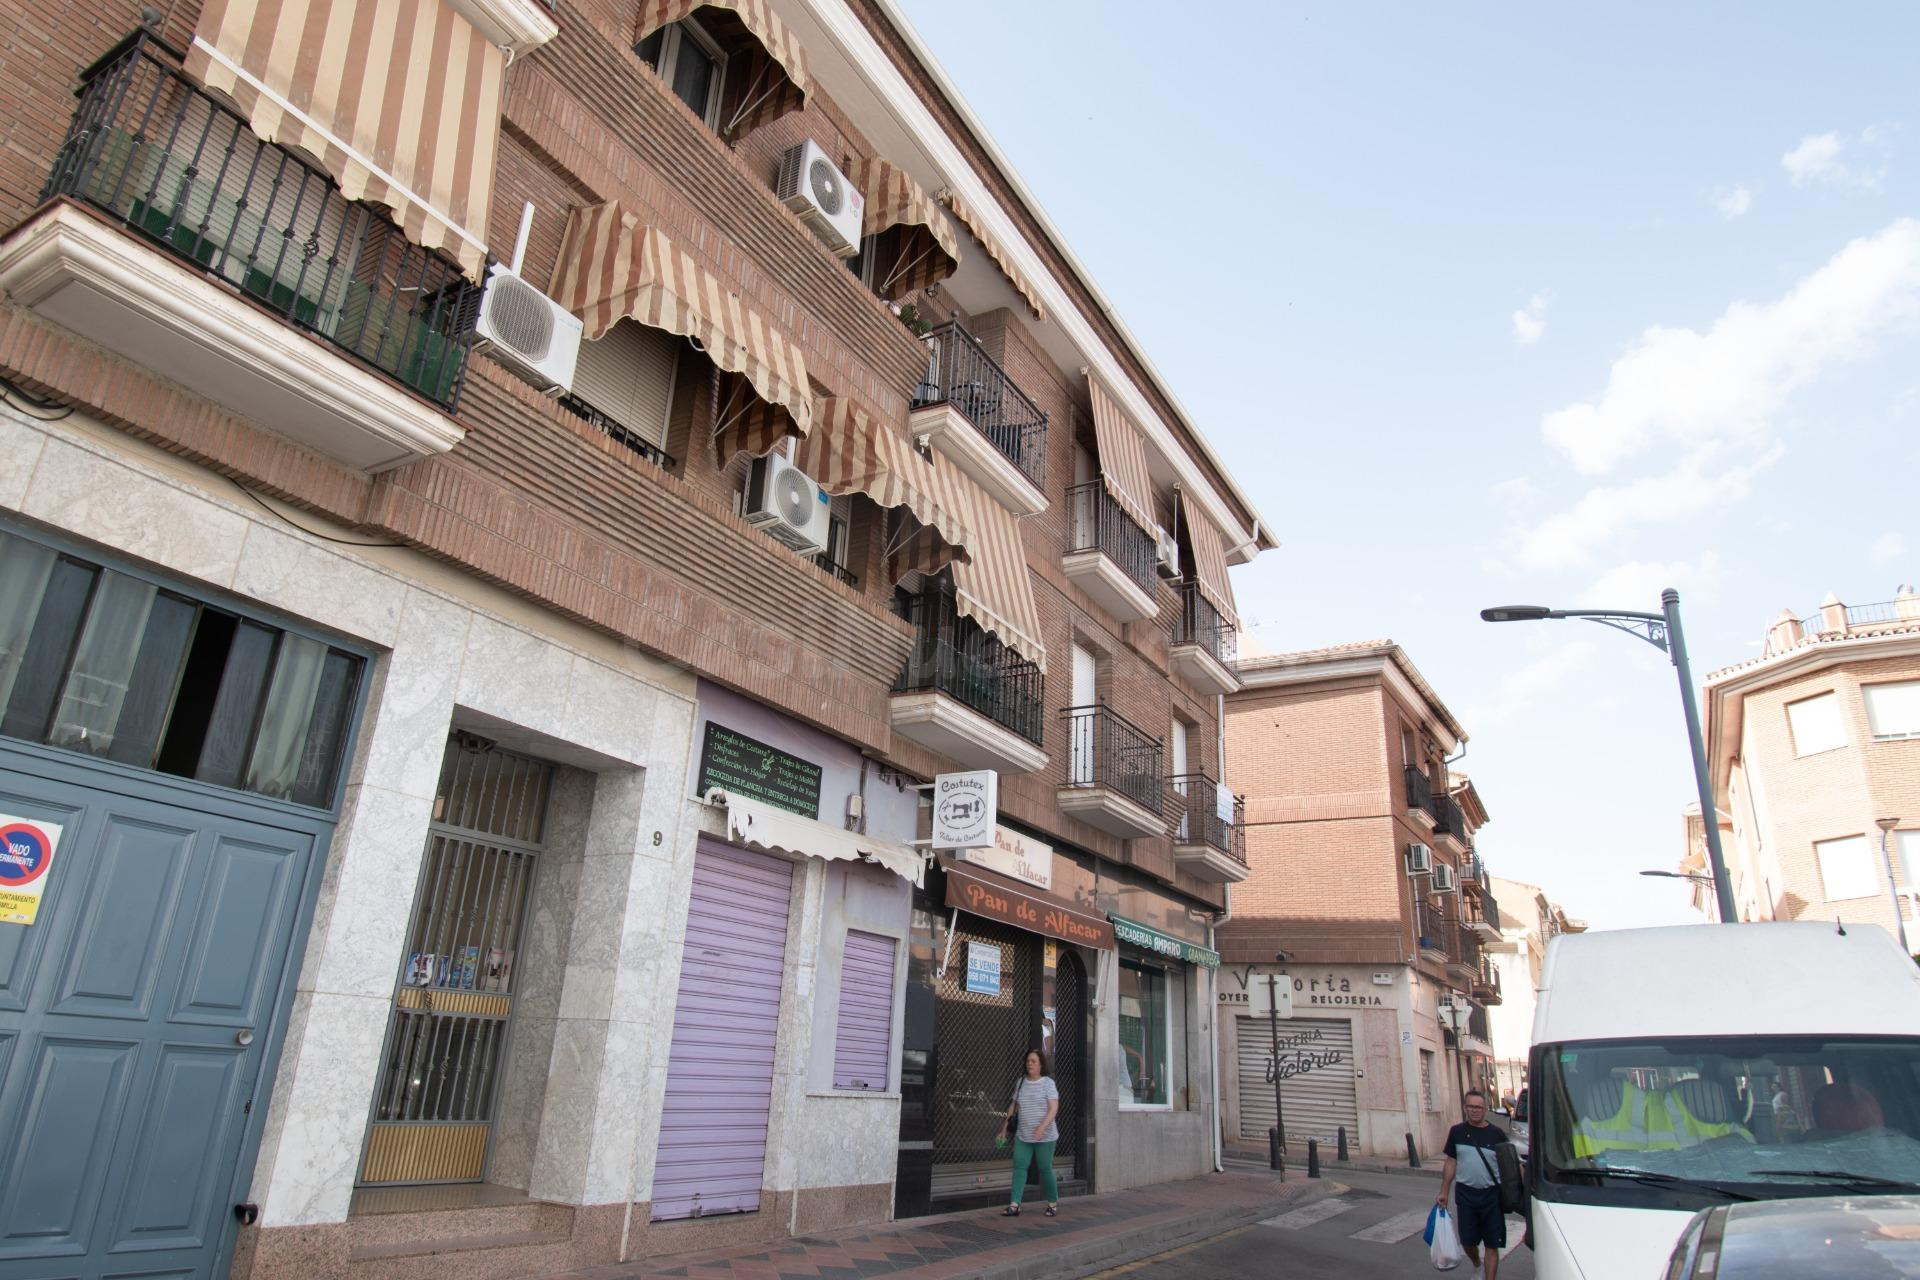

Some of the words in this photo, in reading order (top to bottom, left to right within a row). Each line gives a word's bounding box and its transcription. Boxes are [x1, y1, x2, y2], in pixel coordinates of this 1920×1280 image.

[714, 742, 739, 757] Disfraces
[941, 778, 985, 793] Costutex
[652, 830, 663, 847] 9
[9, 842, 30, 857] VADO
[1014, 840, 1025, 857] de
[0, 853, 35, 867] ERMANENTE
[1012, 859, 1048, 885] Alfacar
[0, 892, 36, 904] UNTAMIENTO
[967, 884, 1008, 913] Pan
[1016, 900, 1038, 922] de
[1044, 911, 1102, 939] Alfacar
[1153, 936, 1181, 956] AMPARO
[969, 957, 978, 968] SE
[979, 960, 1000, 973] VENDE
[1232, 964, 1350, 992] Voria
[1218, 993, 1249, 1003] OYER
[1311, 995, 1382, 1005] RELOJERIA
[1264, 1047, 1344, 1084] Victoria
